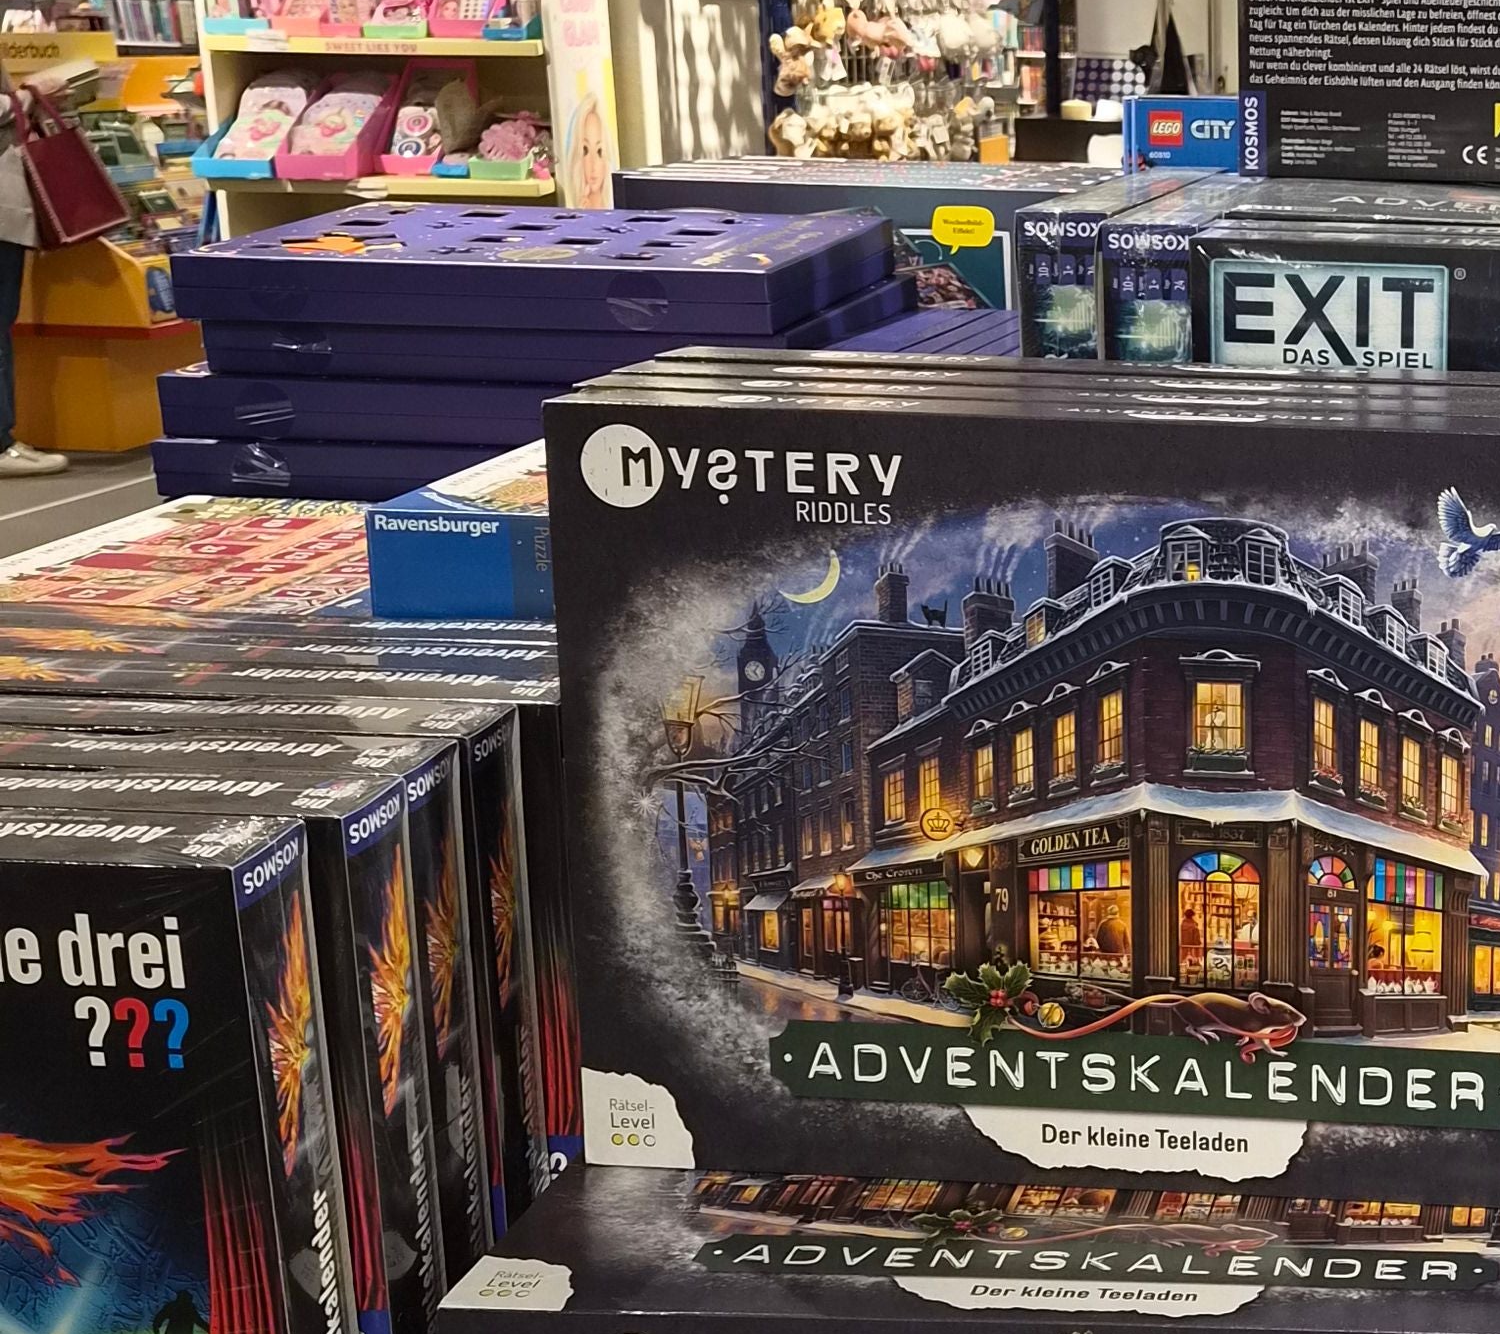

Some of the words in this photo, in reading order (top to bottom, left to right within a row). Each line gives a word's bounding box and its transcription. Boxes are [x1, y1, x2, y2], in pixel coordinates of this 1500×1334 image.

[1152, 121, 1182, 135] LEGO
[1190, 119, 1236, 140] CITY
[1244, 97, 1260, 167] KOSMOS
[1107, 232, 1190, 252] KOSMOS
[1222, 273, 1437, 367] EXIT
[1282, 347, 1330, 366] DAS
[1361, 349, 1434, 369] SPIEL
[606, 439, 901, 505] MYSTERY
[375, 514, 499, 538] Ravensburger
[796, 500, 892, 525] RIDDLES
[533, 525, 550, 573] Puzzle
[348, 793, 401, 845] KOSMOS
[1030, 829, 1079, 857] GOLDEN
[1083, 825, 1111, 849] TEA
[242, 836, 300, 896] KOSMOS
[994, 887, 1010, 913] 79
[57, 914, 186, 991] drei
[74, 997, 190, 1068] ???
[808, 1041, 1487, 1113] ADVENTSKALENDER
[609, 1097, 656, 1113] Rätsel-
[610, 1112, 656, 1131] Level
[1041, 1124, 1081, 1146] Der
[1086, 1127, 1150, 1149] kleine
[1156, 1130, 1249, 1154] Teeladen
[733, 1243, 1459, 1281] ADVENTSKALENDER
[970, 1284, 1016, 1298] Der
[1019, 1285, 1090, 1302] kleine
[1098, 1287, 1198, 1304] Teeladen
